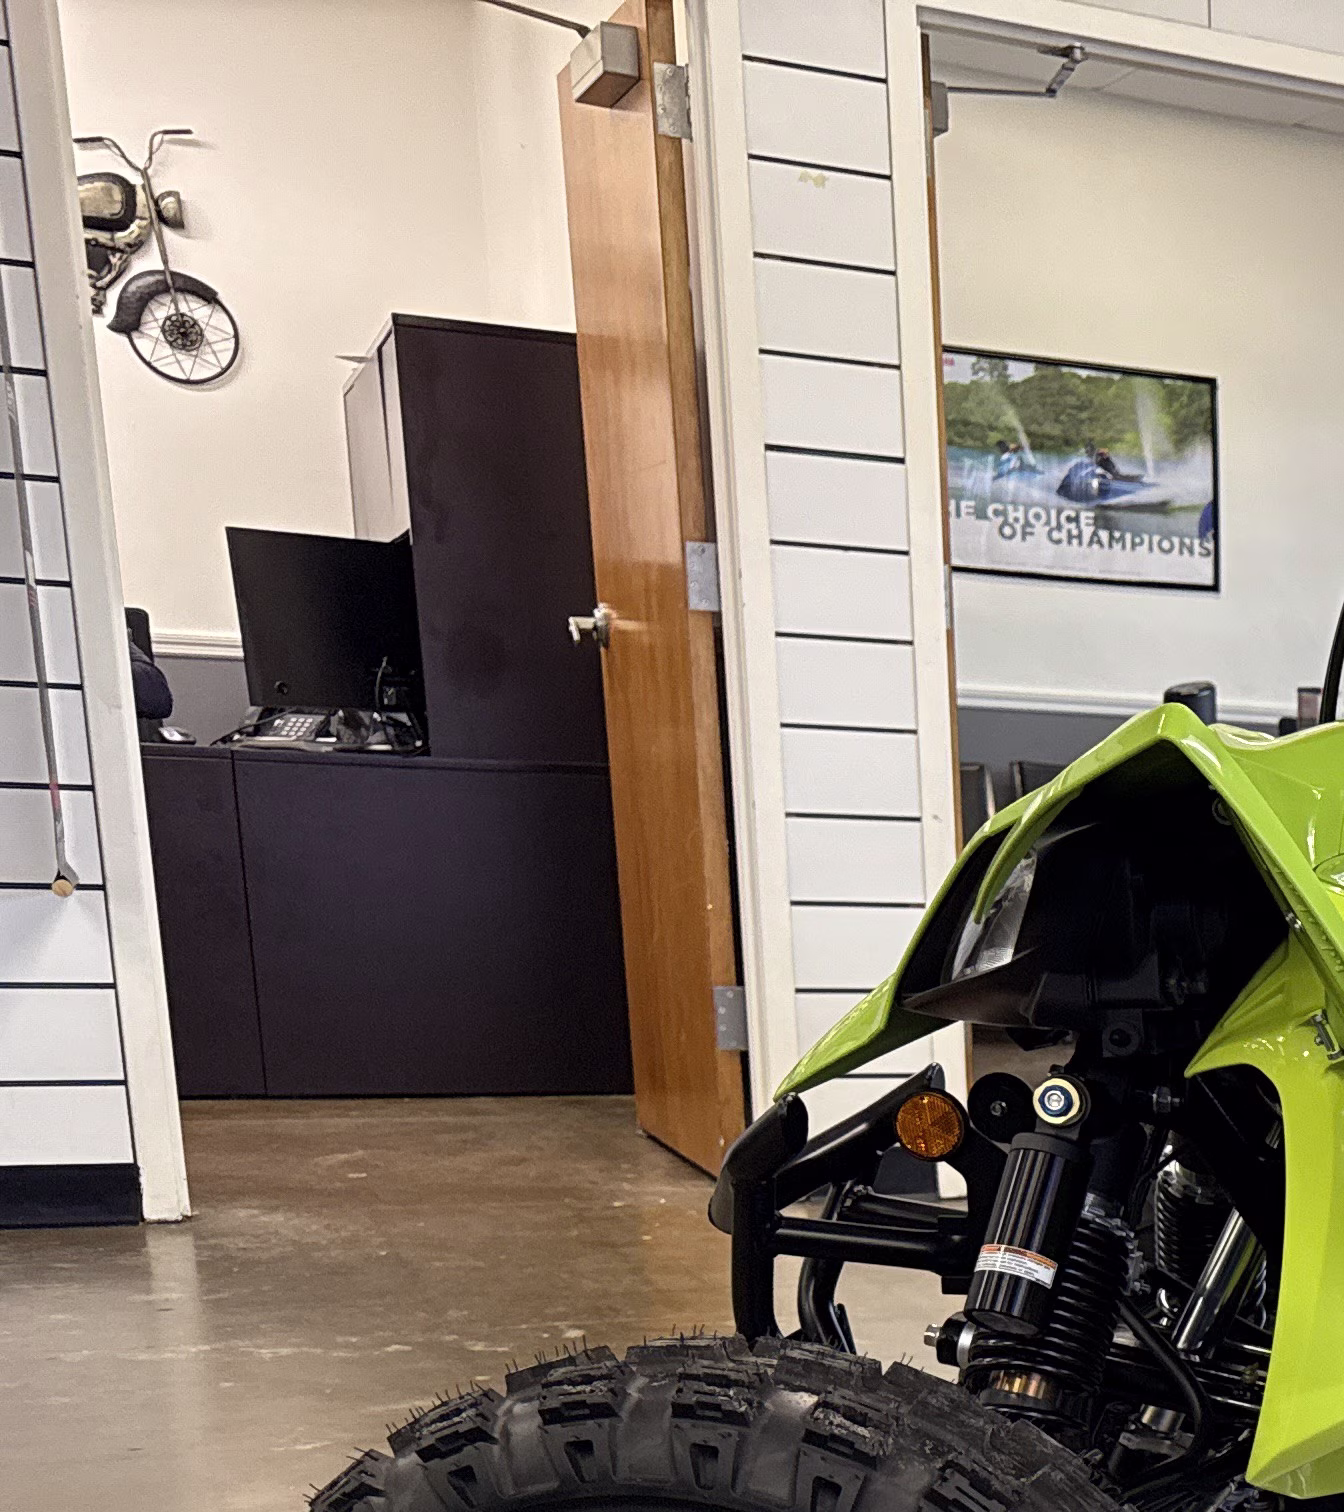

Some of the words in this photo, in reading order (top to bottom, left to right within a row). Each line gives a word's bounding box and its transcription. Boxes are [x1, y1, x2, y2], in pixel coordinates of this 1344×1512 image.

[987, 502, 1096, 530] CHOICE
[998, 520, 1035, 542] OF
[1046, 526, 1213, 559] CHAMPIONS
